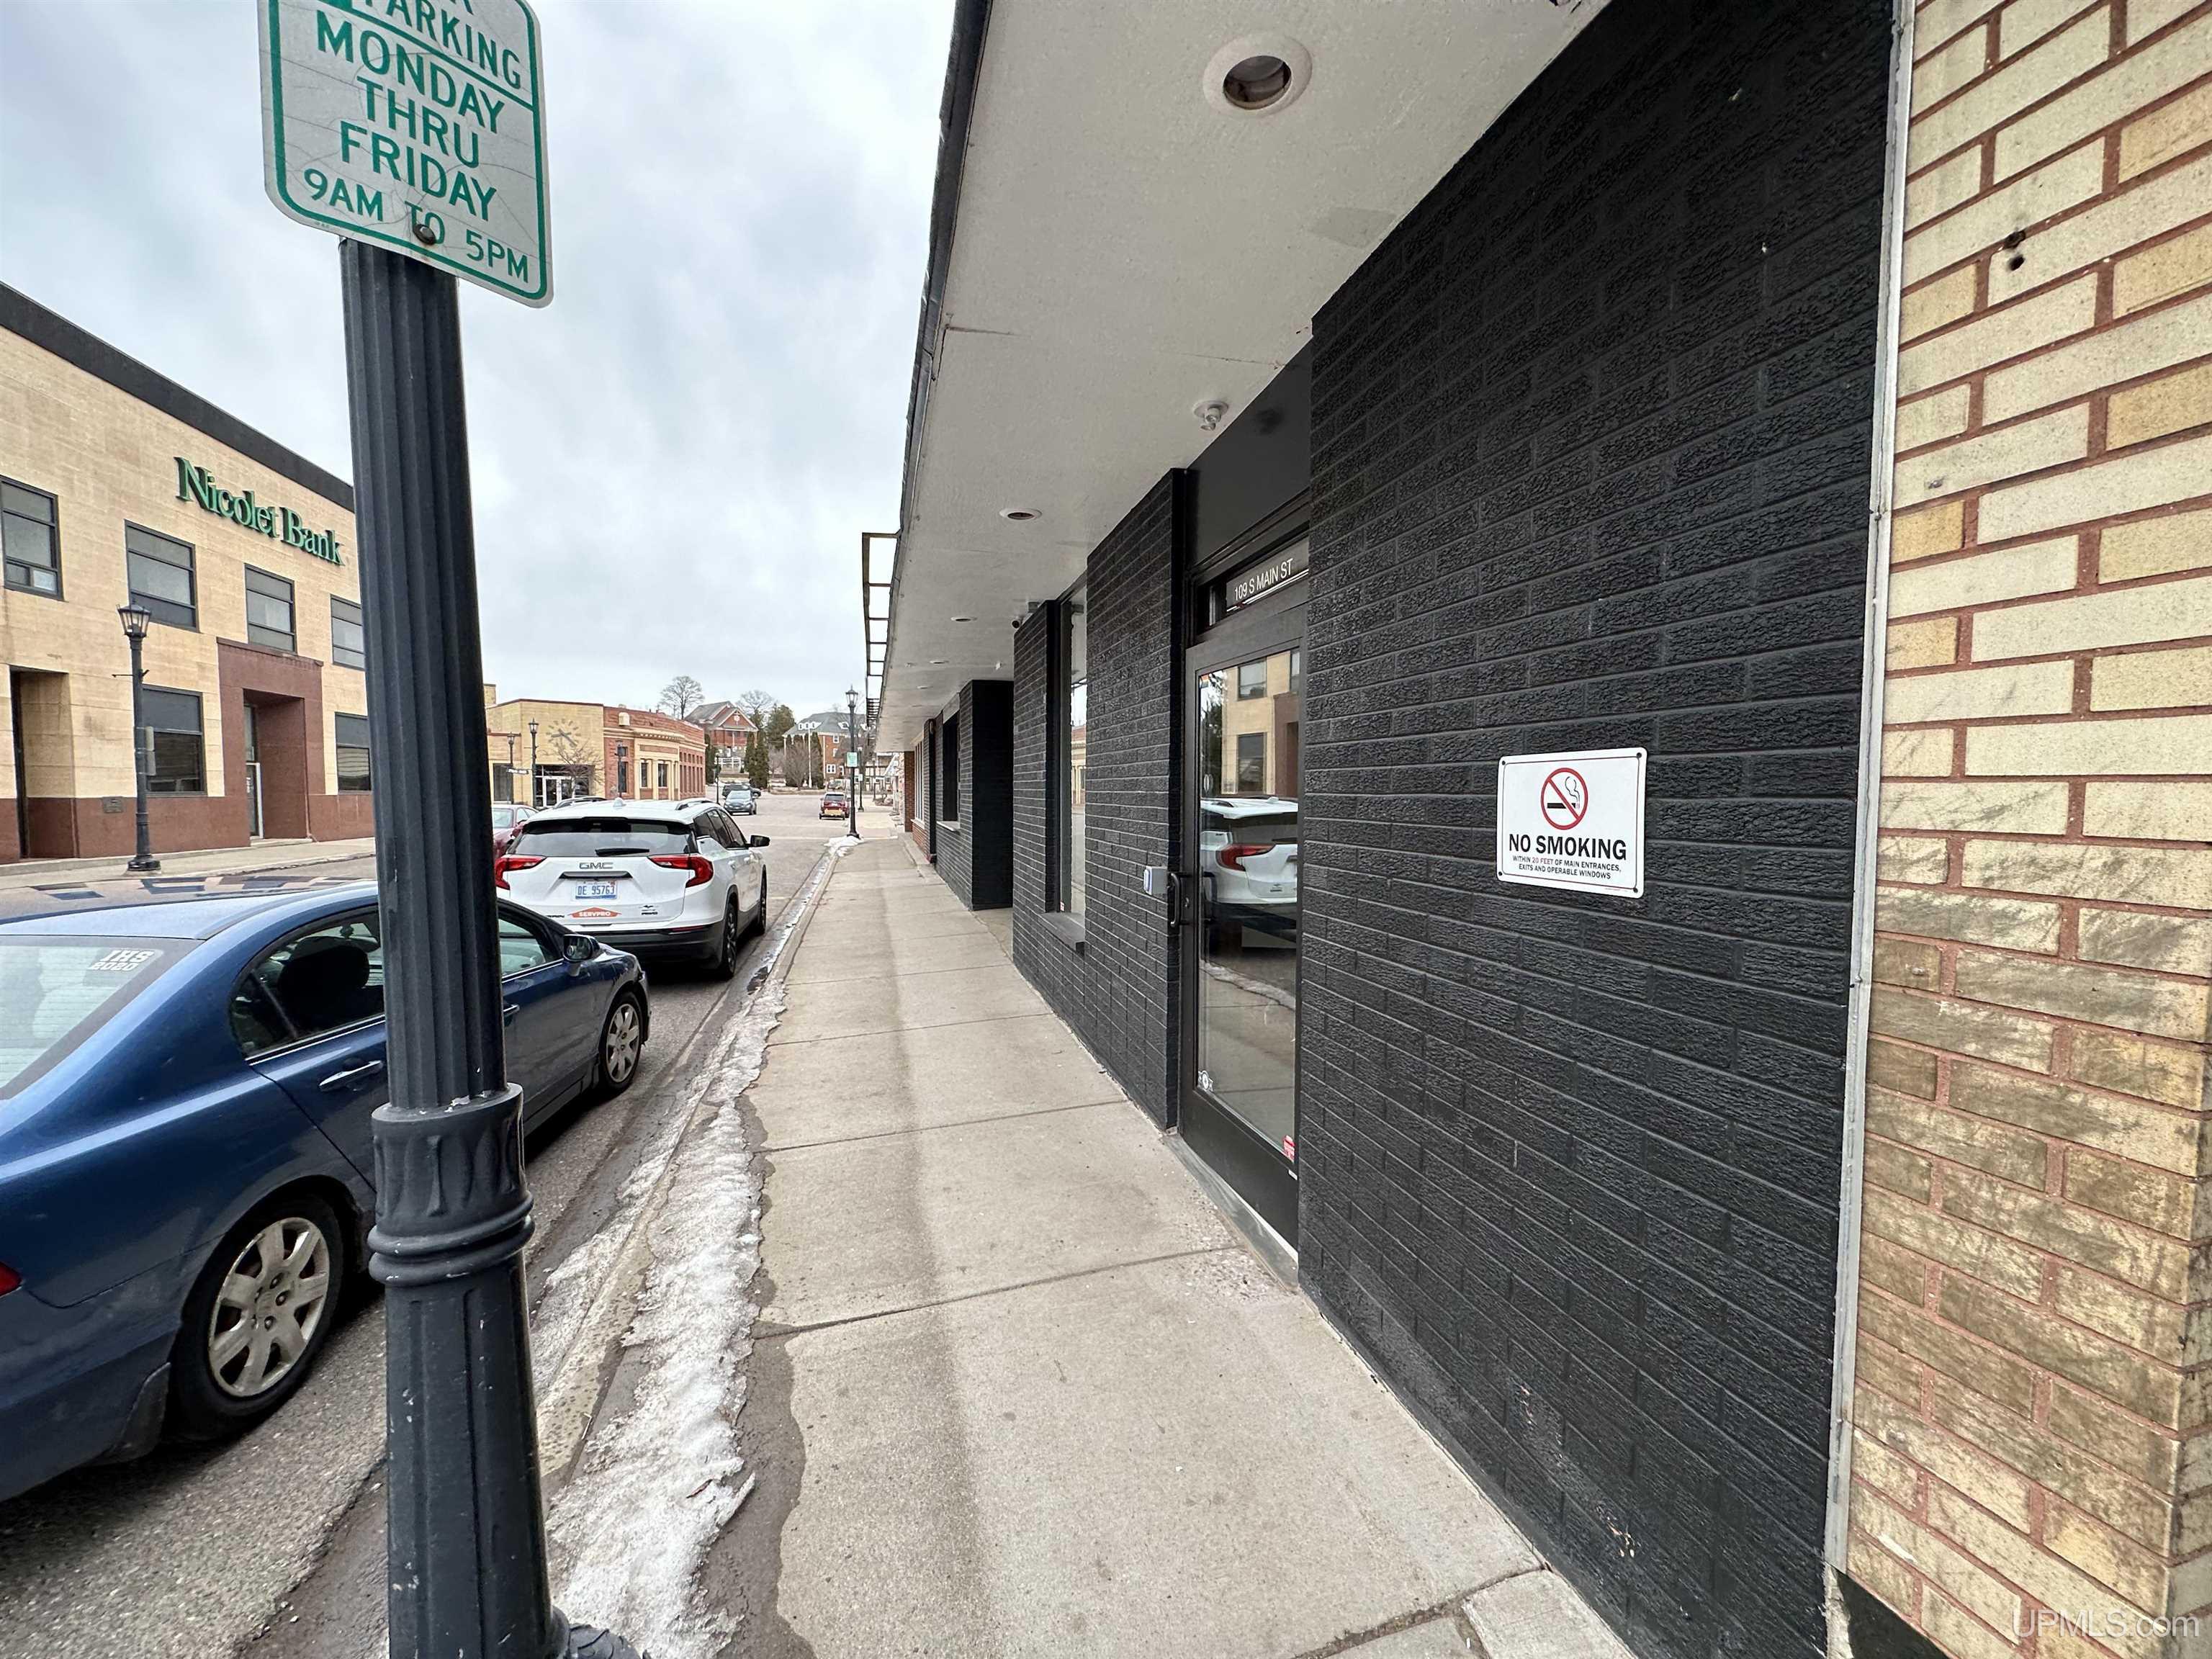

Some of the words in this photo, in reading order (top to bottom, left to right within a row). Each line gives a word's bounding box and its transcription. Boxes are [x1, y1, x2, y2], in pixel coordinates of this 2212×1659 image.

[316, 10, 505, 134] MONDAY
[365, 0, 521, 89] ARKING
[357, 76, 479, 168] THRU
[340, 120, 497, 221] FRIDAY
[304, 168, 383, 221] 9AM
[404, 200, 446, 245] TO
[466, 229, 529, 283] 5PM
[174, 457, 279, 538] Nicolet
[279, 507, 346, 566] Bank
[1234, 583, 1248, 601] 109
[1249, 578, 1255, 594] S
[1256, 565, 1279, 590] MAIN
[1280, 558, 1293, 578] ST
[1509, 834, 1531, 853] NO
[1535, 835, 1627, 860] SMOKING
[1547, 866, 1578, 876] OPERABLE
[1579, 871, 1611, 880] WINDOWS
[592, 885, 615, 895] 95763
[87, 962, 139, 971] 2020
[99, 950, 155, 963] IHS
